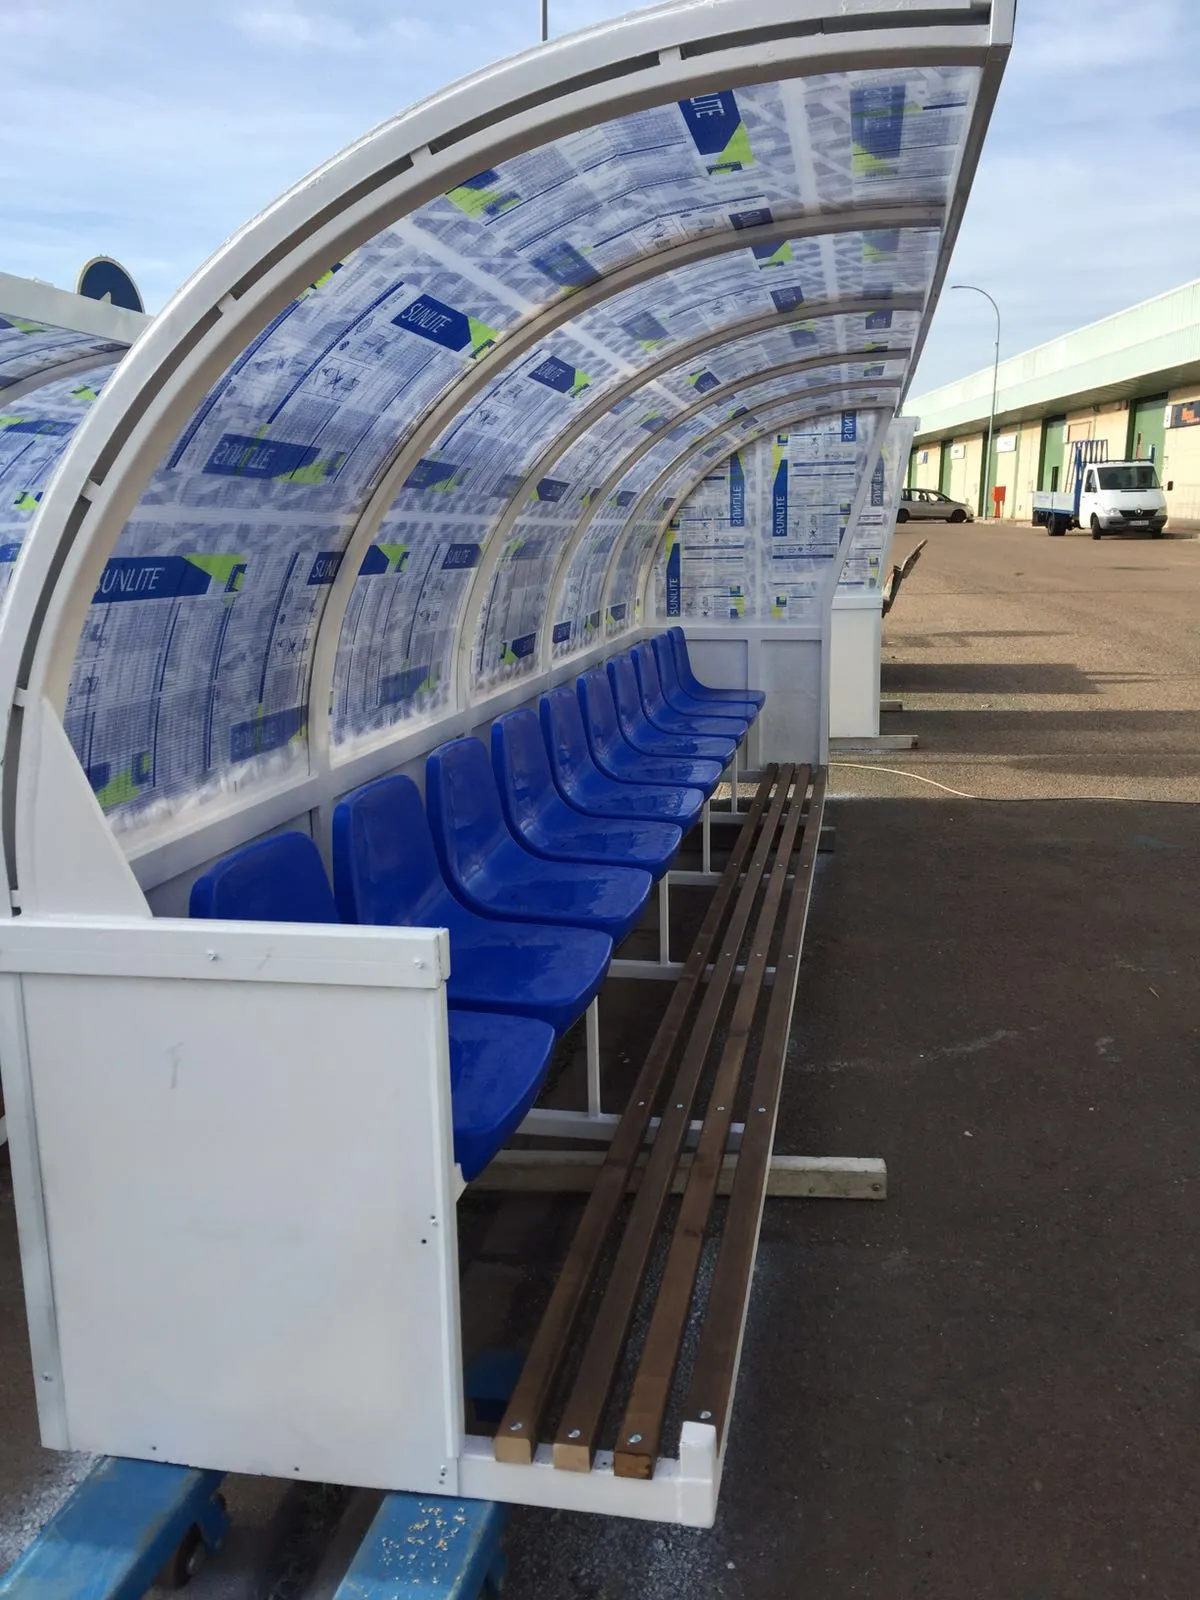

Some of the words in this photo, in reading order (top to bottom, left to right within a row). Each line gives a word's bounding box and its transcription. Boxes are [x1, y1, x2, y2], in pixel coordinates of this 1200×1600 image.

[401, 303, 452, 334] SUNLITE
[775, 495, 785, 535] SUNLITE
[98, 567, 165, 595] UNLITE
[669, 578, 679, 615] SUNLITE
